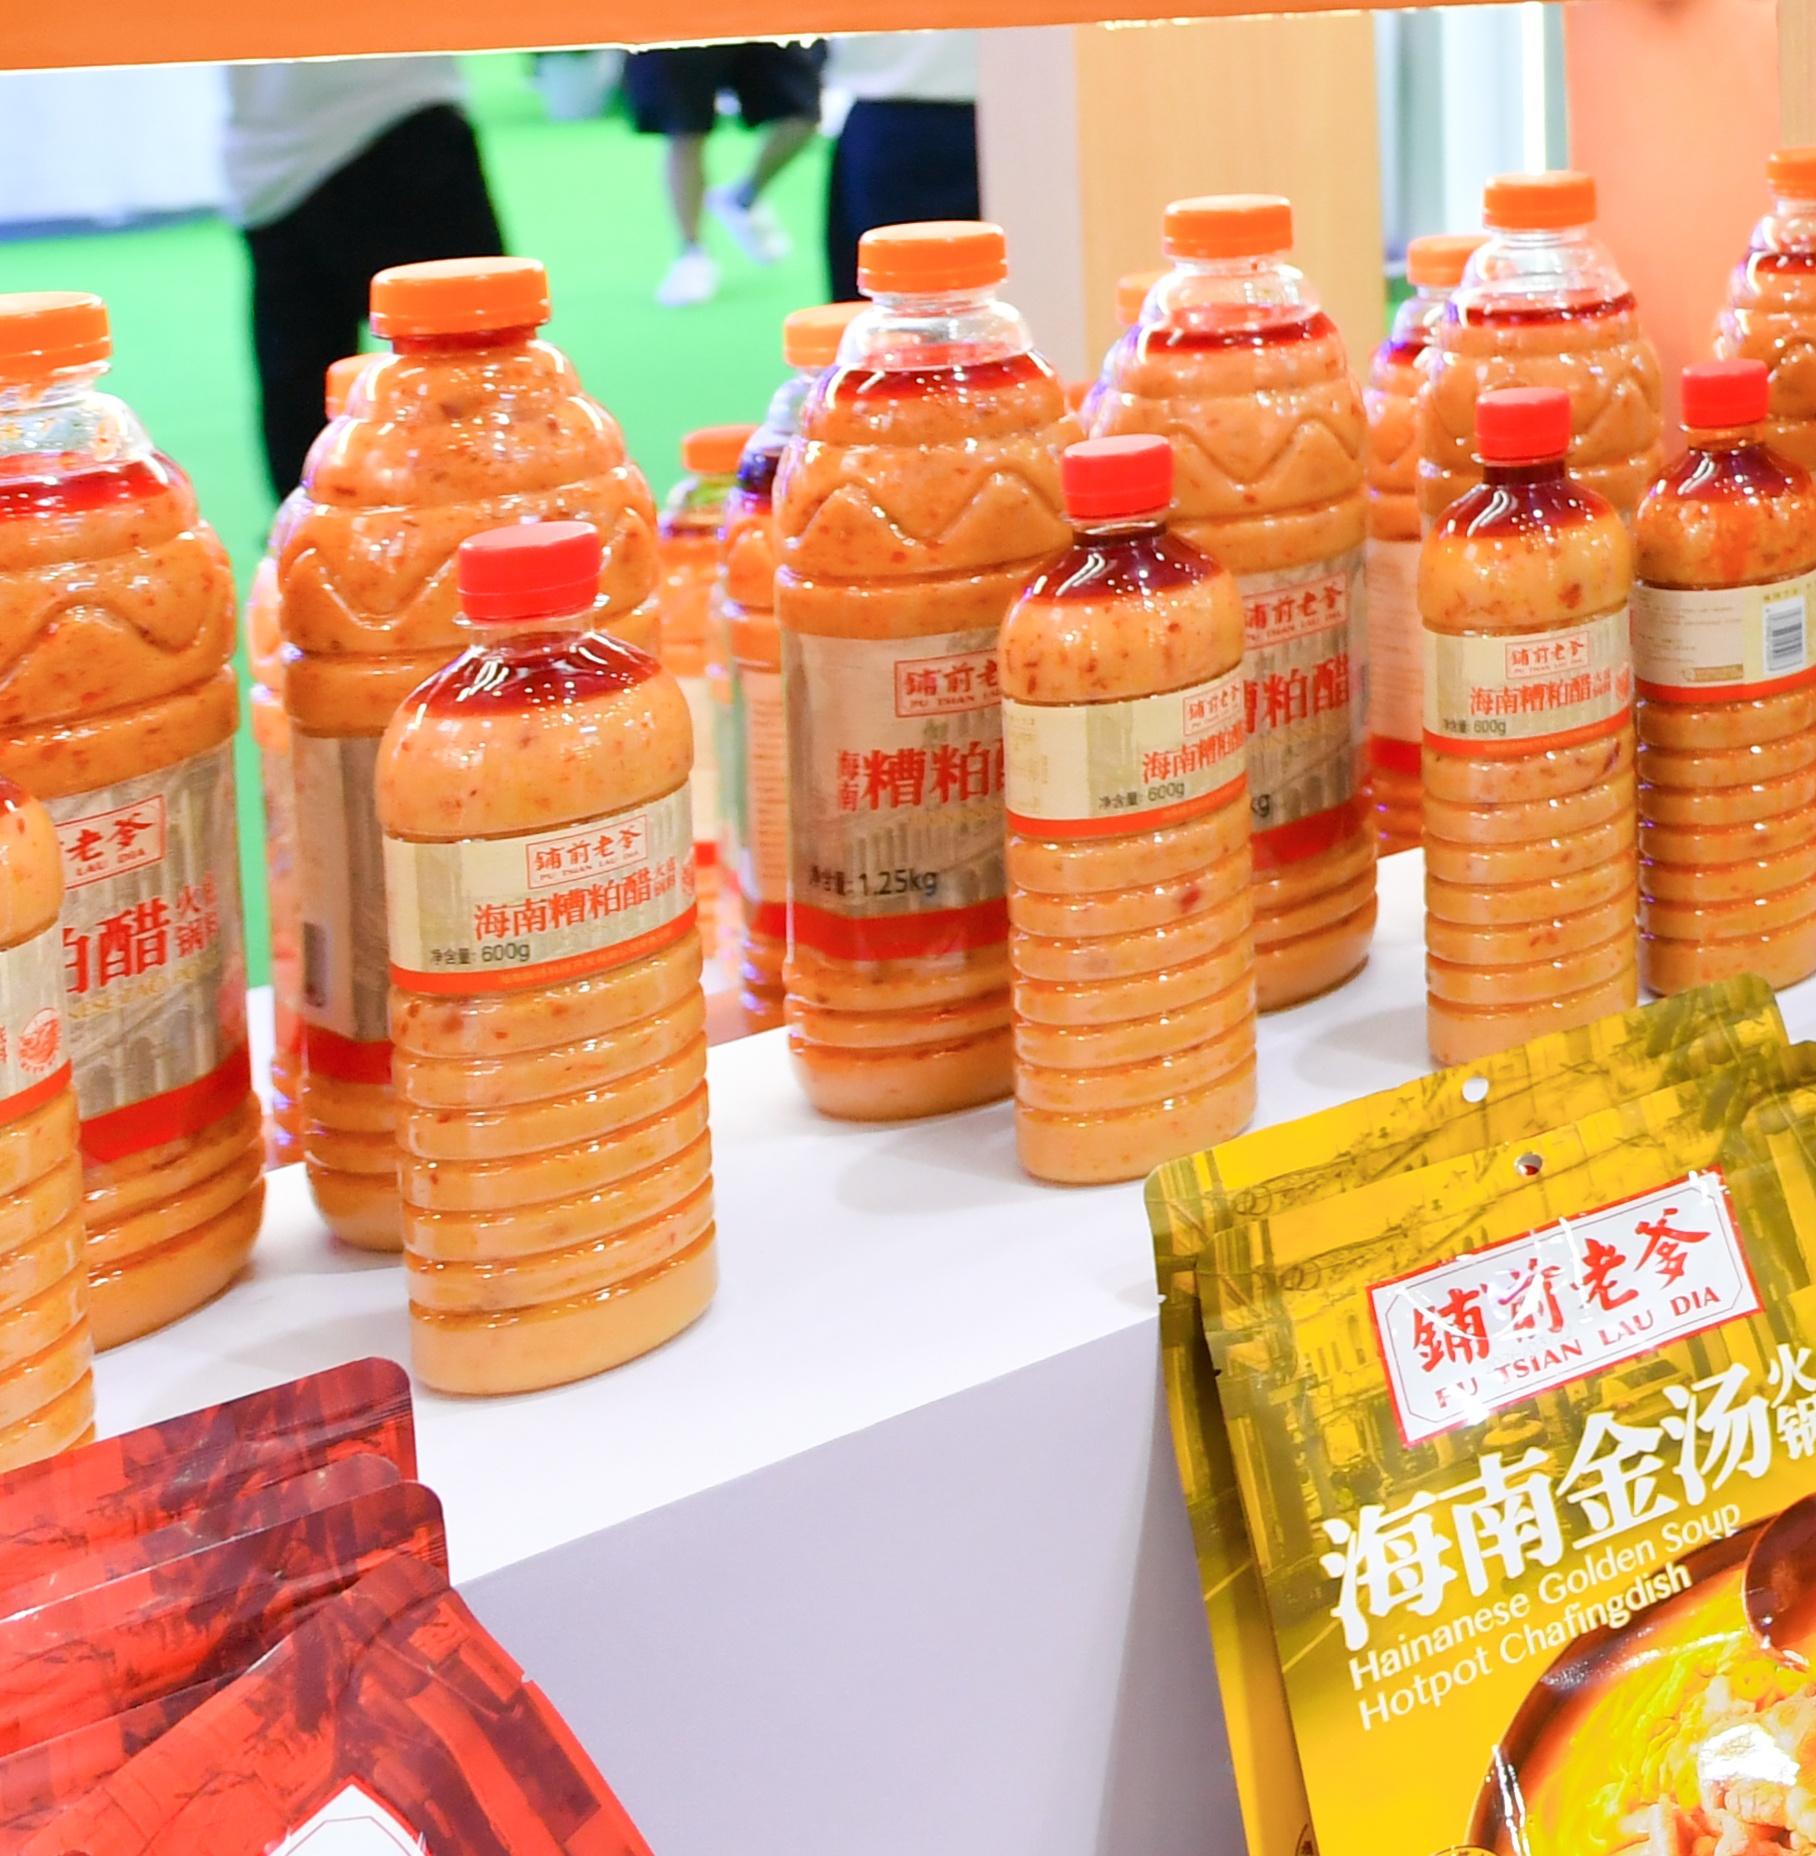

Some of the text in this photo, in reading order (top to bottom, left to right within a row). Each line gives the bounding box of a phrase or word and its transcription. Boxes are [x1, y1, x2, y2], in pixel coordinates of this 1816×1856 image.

[1146, 781, 1186, 803] 600g
[474, 866, 652, 942] 海南糟粕醋
[857, 868, 939, 898] 1.25kg
[480, 942, 531, 964] 600g
[1494, 1337, 1584, 1385] TSIAN
[1598, 1308, 1656, 1347] LAU
[1669, 1285, 1722, 1318] DIA
[1318, 1361, 1773, 1650] 海南金汤
[1348, 1501, 1743, 1693] Hainanese Golden Soup
[1358, 1558, 1693, 1732] Hotpot Chafingdish
